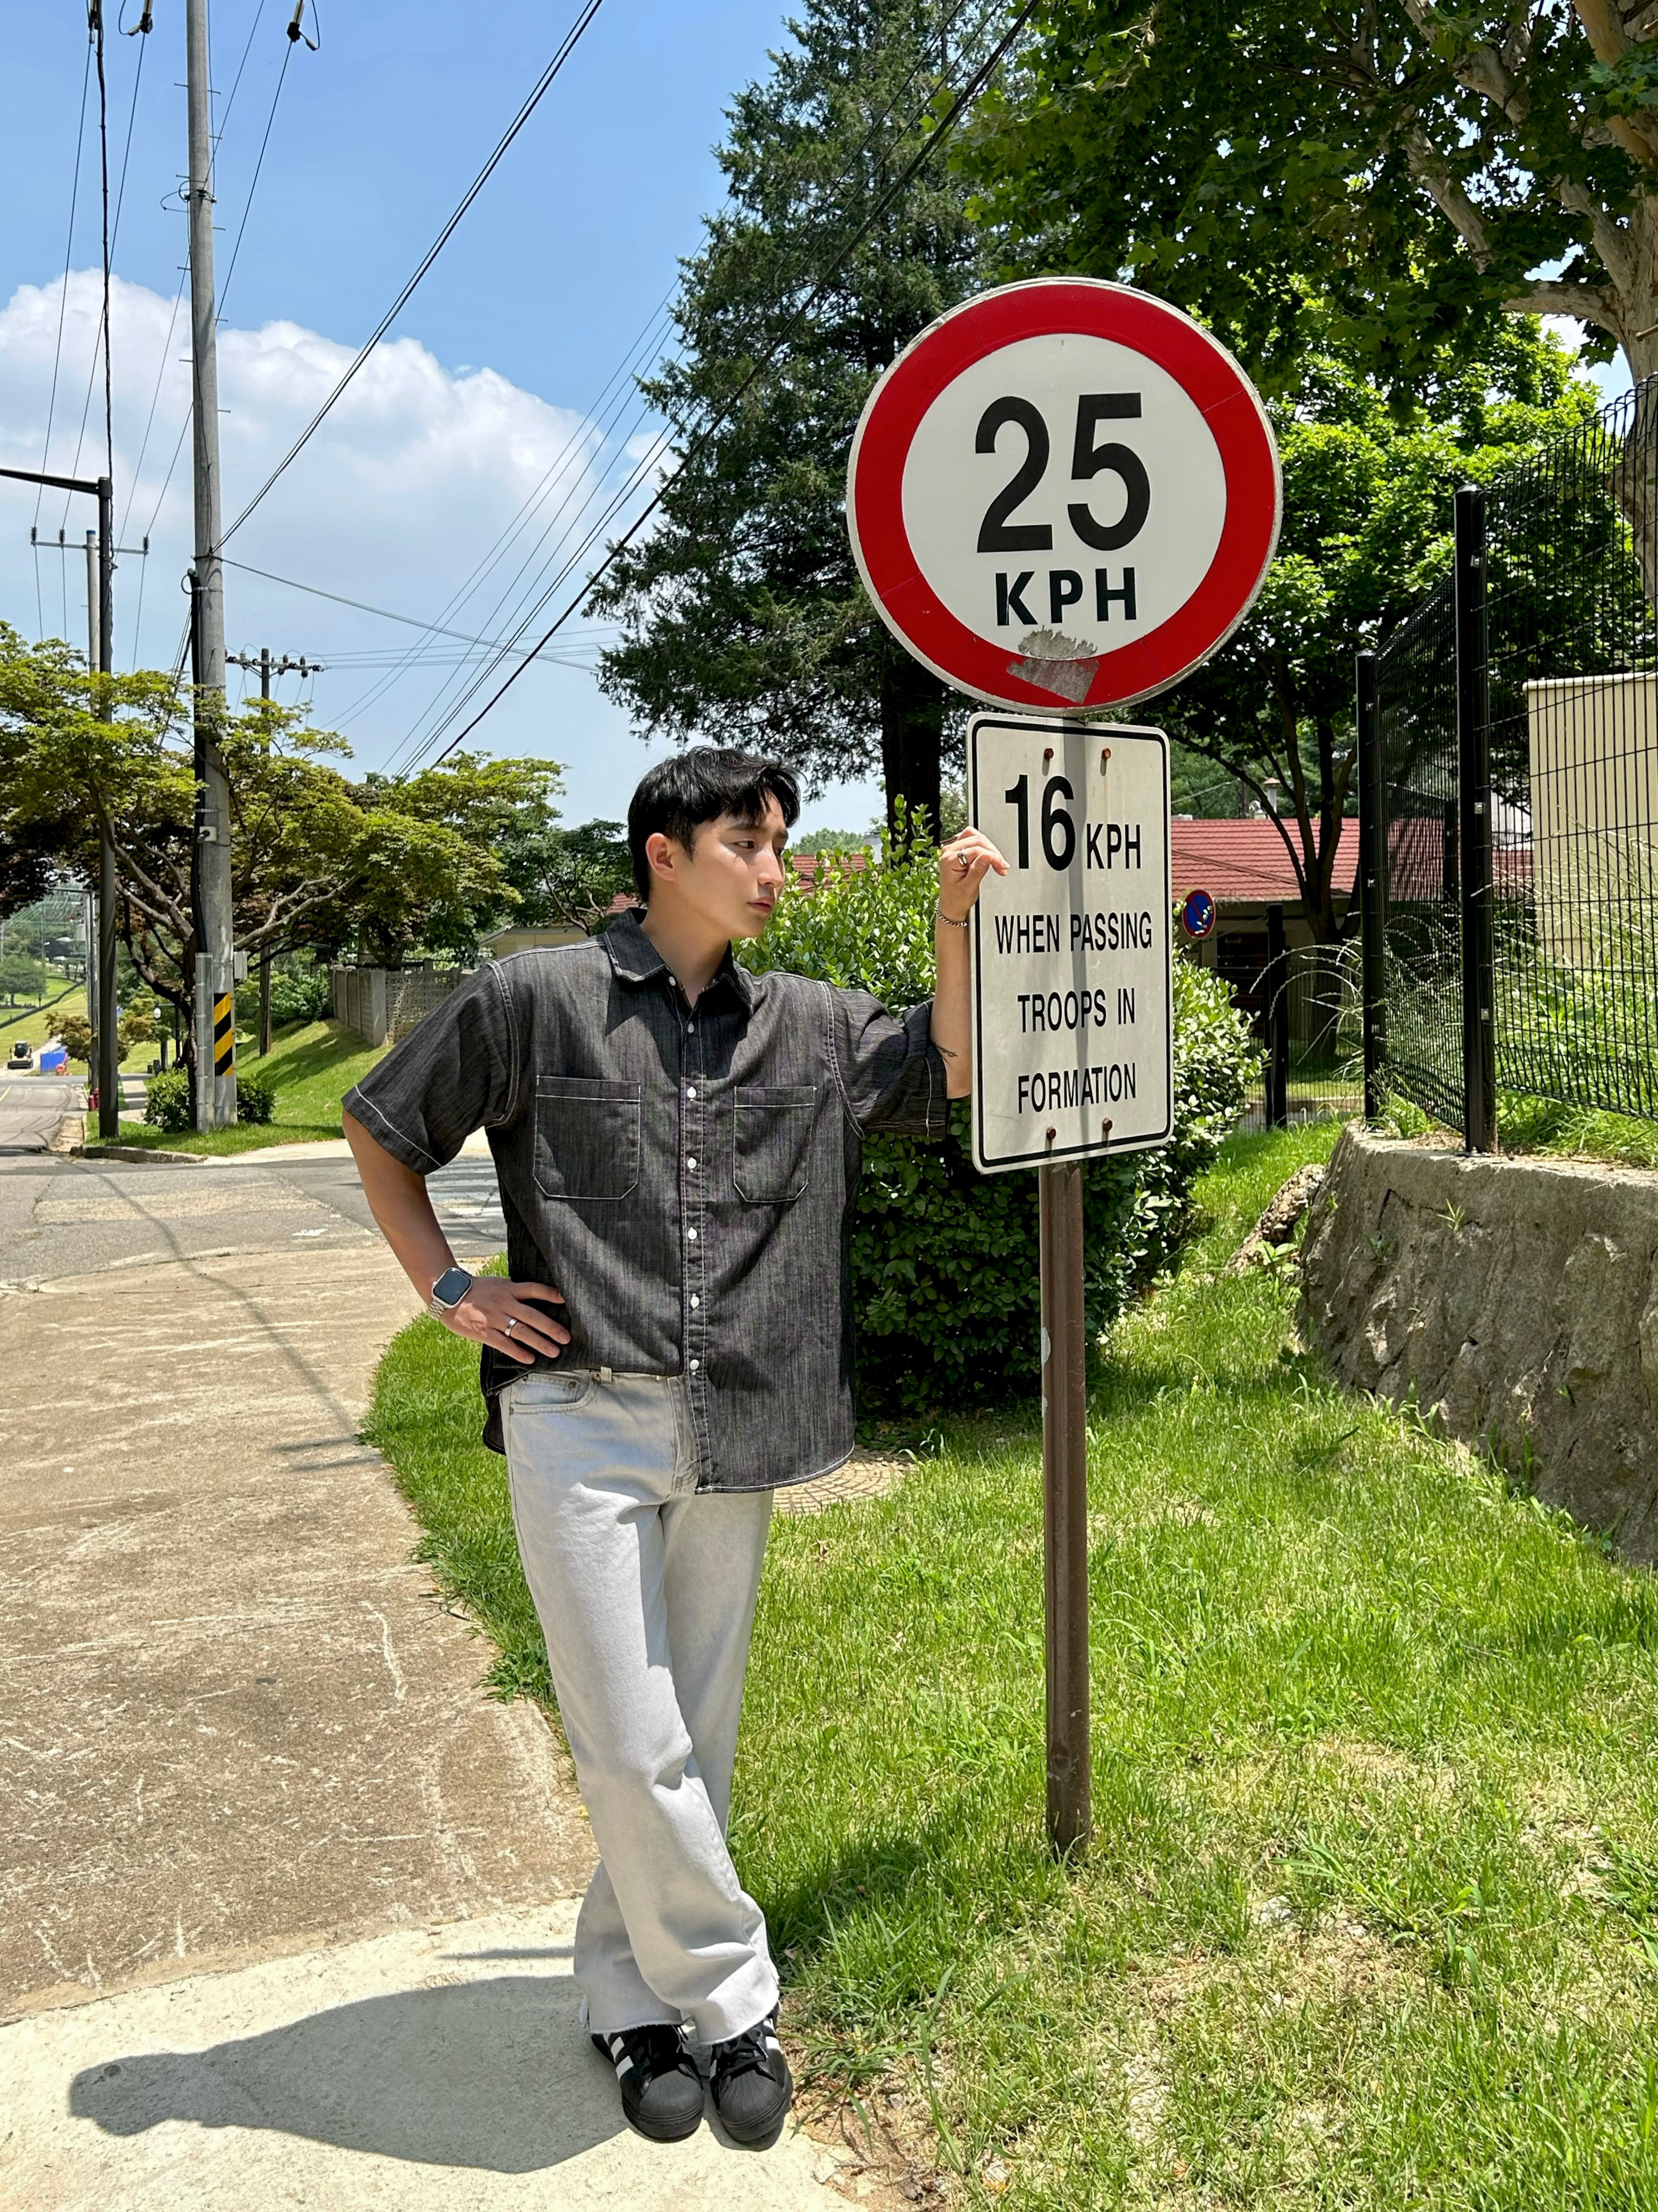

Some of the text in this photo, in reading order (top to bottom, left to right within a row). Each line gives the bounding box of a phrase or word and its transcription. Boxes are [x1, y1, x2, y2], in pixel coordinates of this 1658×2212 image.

[975, 392, 1150, 553] 25
[995, 567, 1137, 626] KPH
[1005, 774, 1141, 871] 16 KPH
[994, 911, 1153, 954] WHEN PASSING
[1017, 988, 1135, 1033] TROOPS IN
[1018, 1063, 1137, 1114] FORMATION
